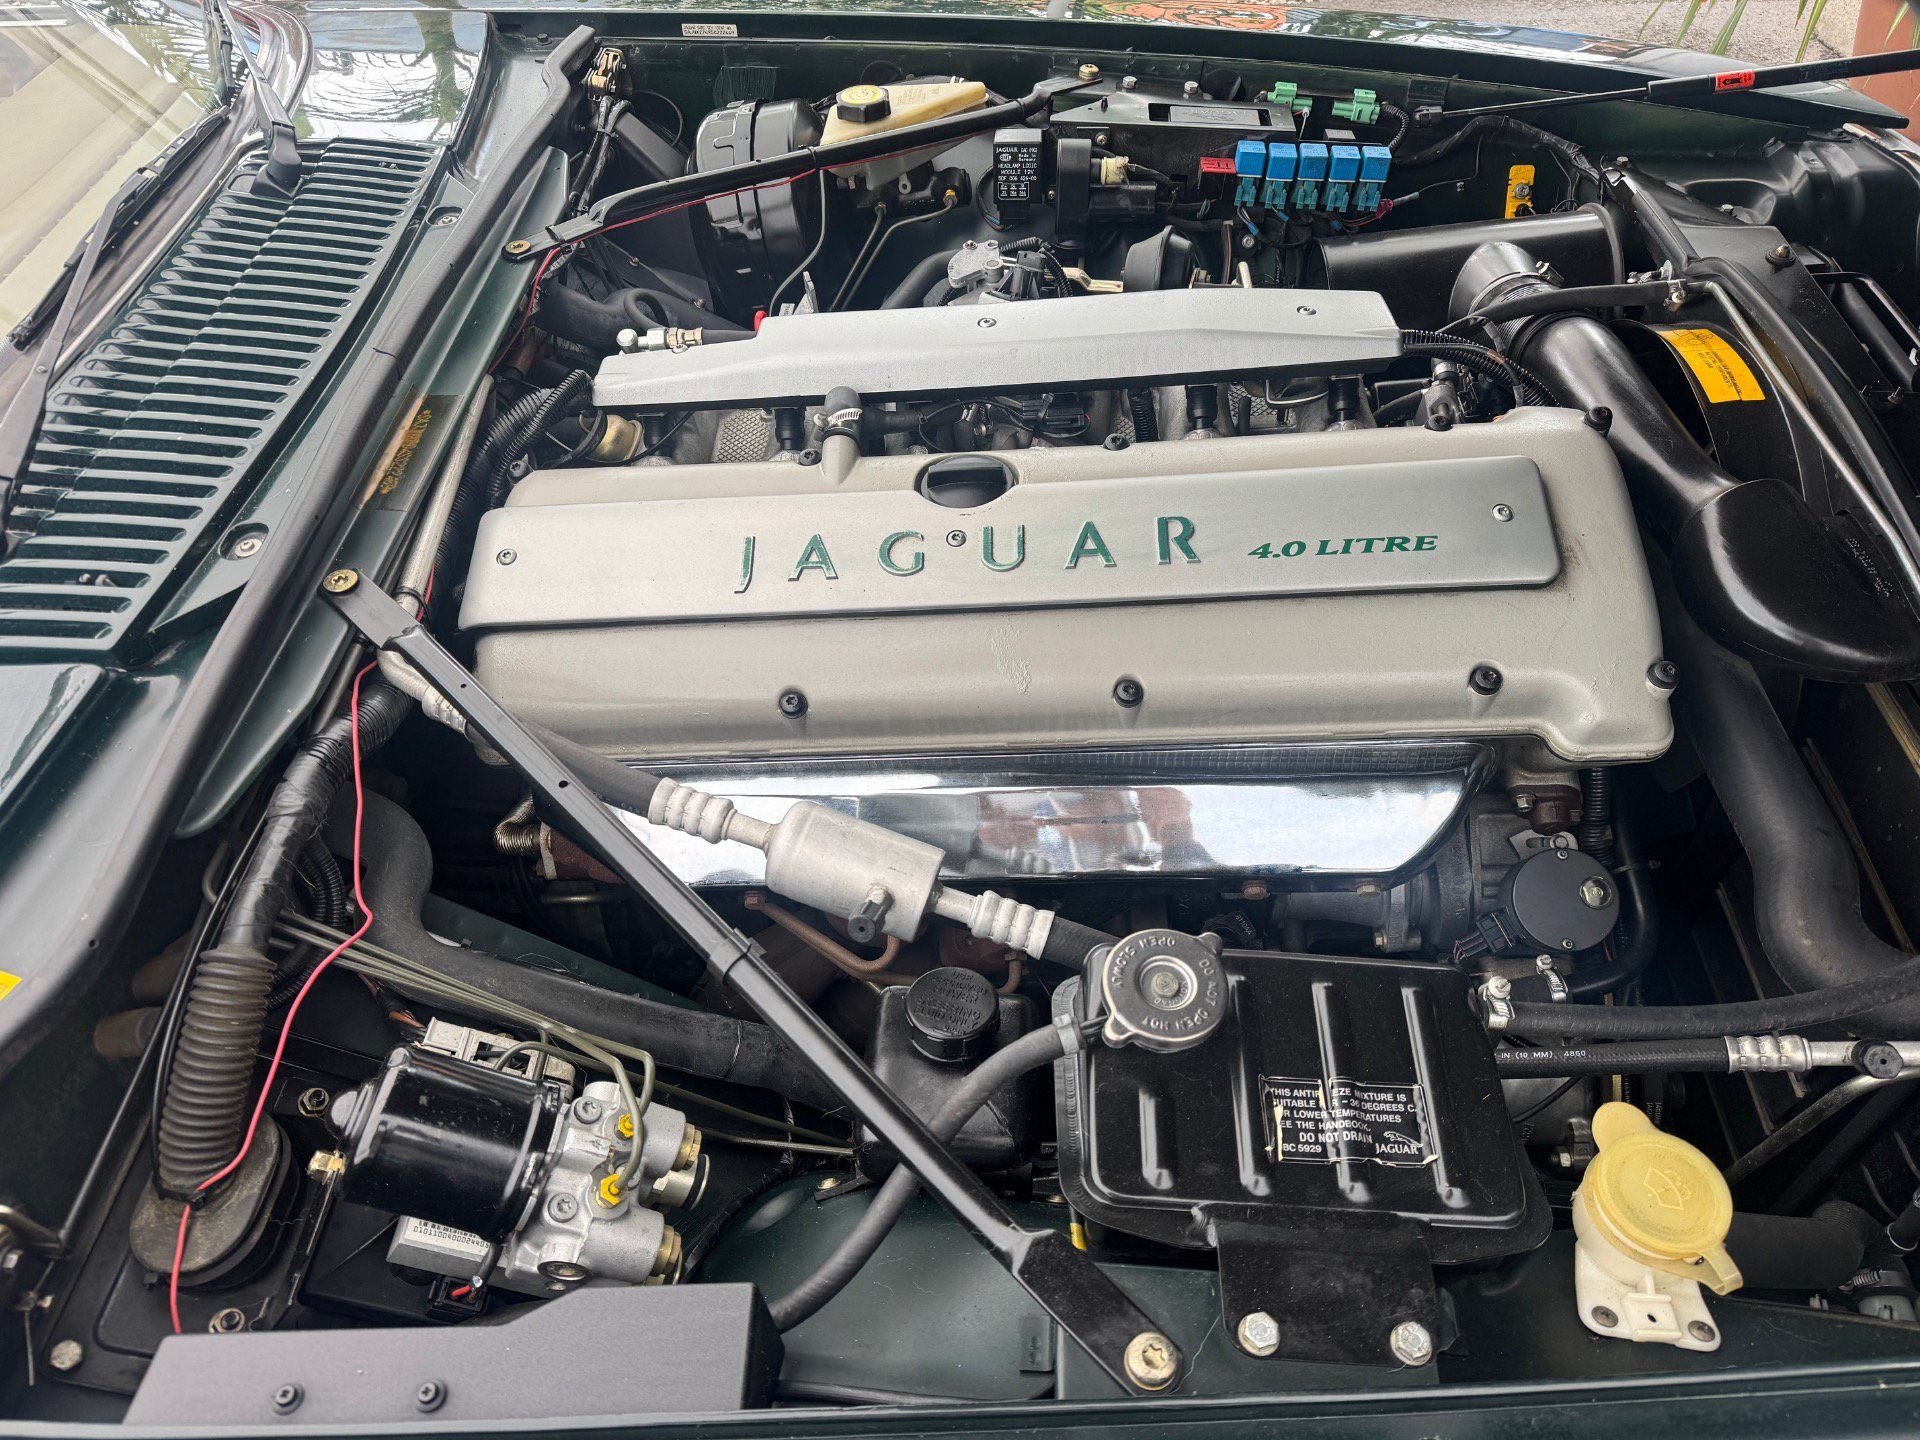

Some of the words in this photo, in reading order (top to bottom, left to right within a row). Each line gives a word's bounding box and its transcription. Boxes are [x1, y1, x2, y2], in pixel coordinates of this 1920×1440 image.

[1248, 540, 1306, 559] 4.0
[1315, 536, 1438, 556] LITRE
[734, 516, 1201, 594] JAGUAR
[1139, 936, 1176, 948] OPEN
[1112, 946, 1136, 988] SLOWLY
[1199, 958, 1215, 974] DO
[1206, 981, 1218, 1007] NOT
[913, 1007, 945, 1020] FLUID
[949, 1014, 978, 1029] ONLY
[1142, 1017, 1168, 1030] HOT
[1176, 1008, 1209, 1030] OPEN
[1293, 1087, 1351, 1098] ANTIFEZE
[1355, 1090, 1394, 1101] MIXTURE
[1397, 1094, 1406, 1102] IS
[1362, 1103, 1404, 1112] DEGREES
[1294, 1110, 1327, 1119] LOWER
[1330, 1109, 1402, 1123] TEMPERATURES
[1281, 1120, 1293, 1128] EE
[1296, 1121, 1315, 1129] THE
[1300, 1133, 1315, 1143] DO
[1319, 1133, 1340, 1143] NOT
[1343, 1131, 1373, 1144] DRAIN
[1283, 1144, 1297, 1152] BC
[1298, 1144, 1322, 1153] 5929
[1376, 1143, 1419, 1155] JAGUAR
